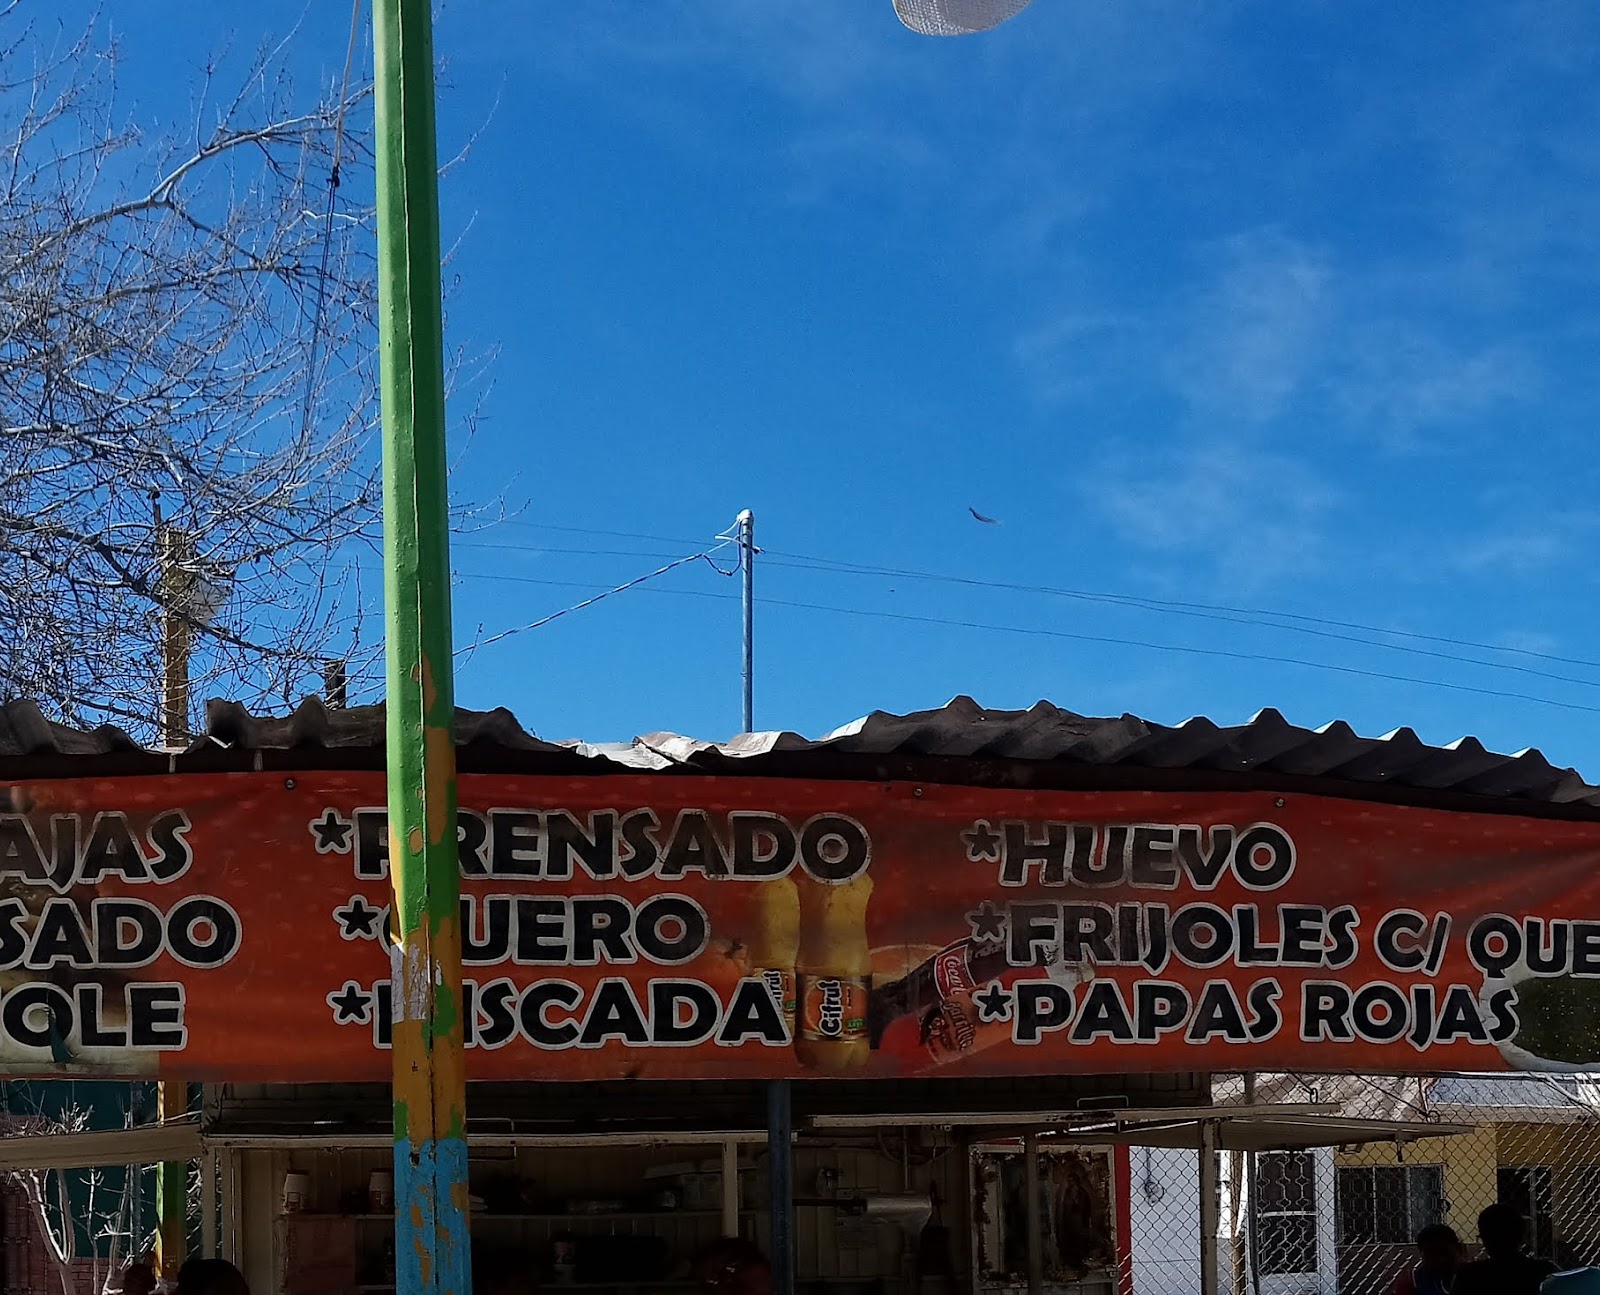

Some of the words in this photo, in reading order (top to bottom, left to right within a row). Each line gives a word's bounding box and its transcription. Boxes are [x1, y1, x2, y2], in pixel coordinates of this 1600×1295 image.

[996, 819, 1297, 891] HUEVO
[378, 892, 711, 966] UERO
[1002, 901, 1361, 975] FRIJOLES
[1373, 909, 1450, 976] C/
[373, 976, 793, 1051] SCADA
[1011, 977, 1283, 1046] PAPAS
[1299, 980, 1520, 1051] ROJAS
